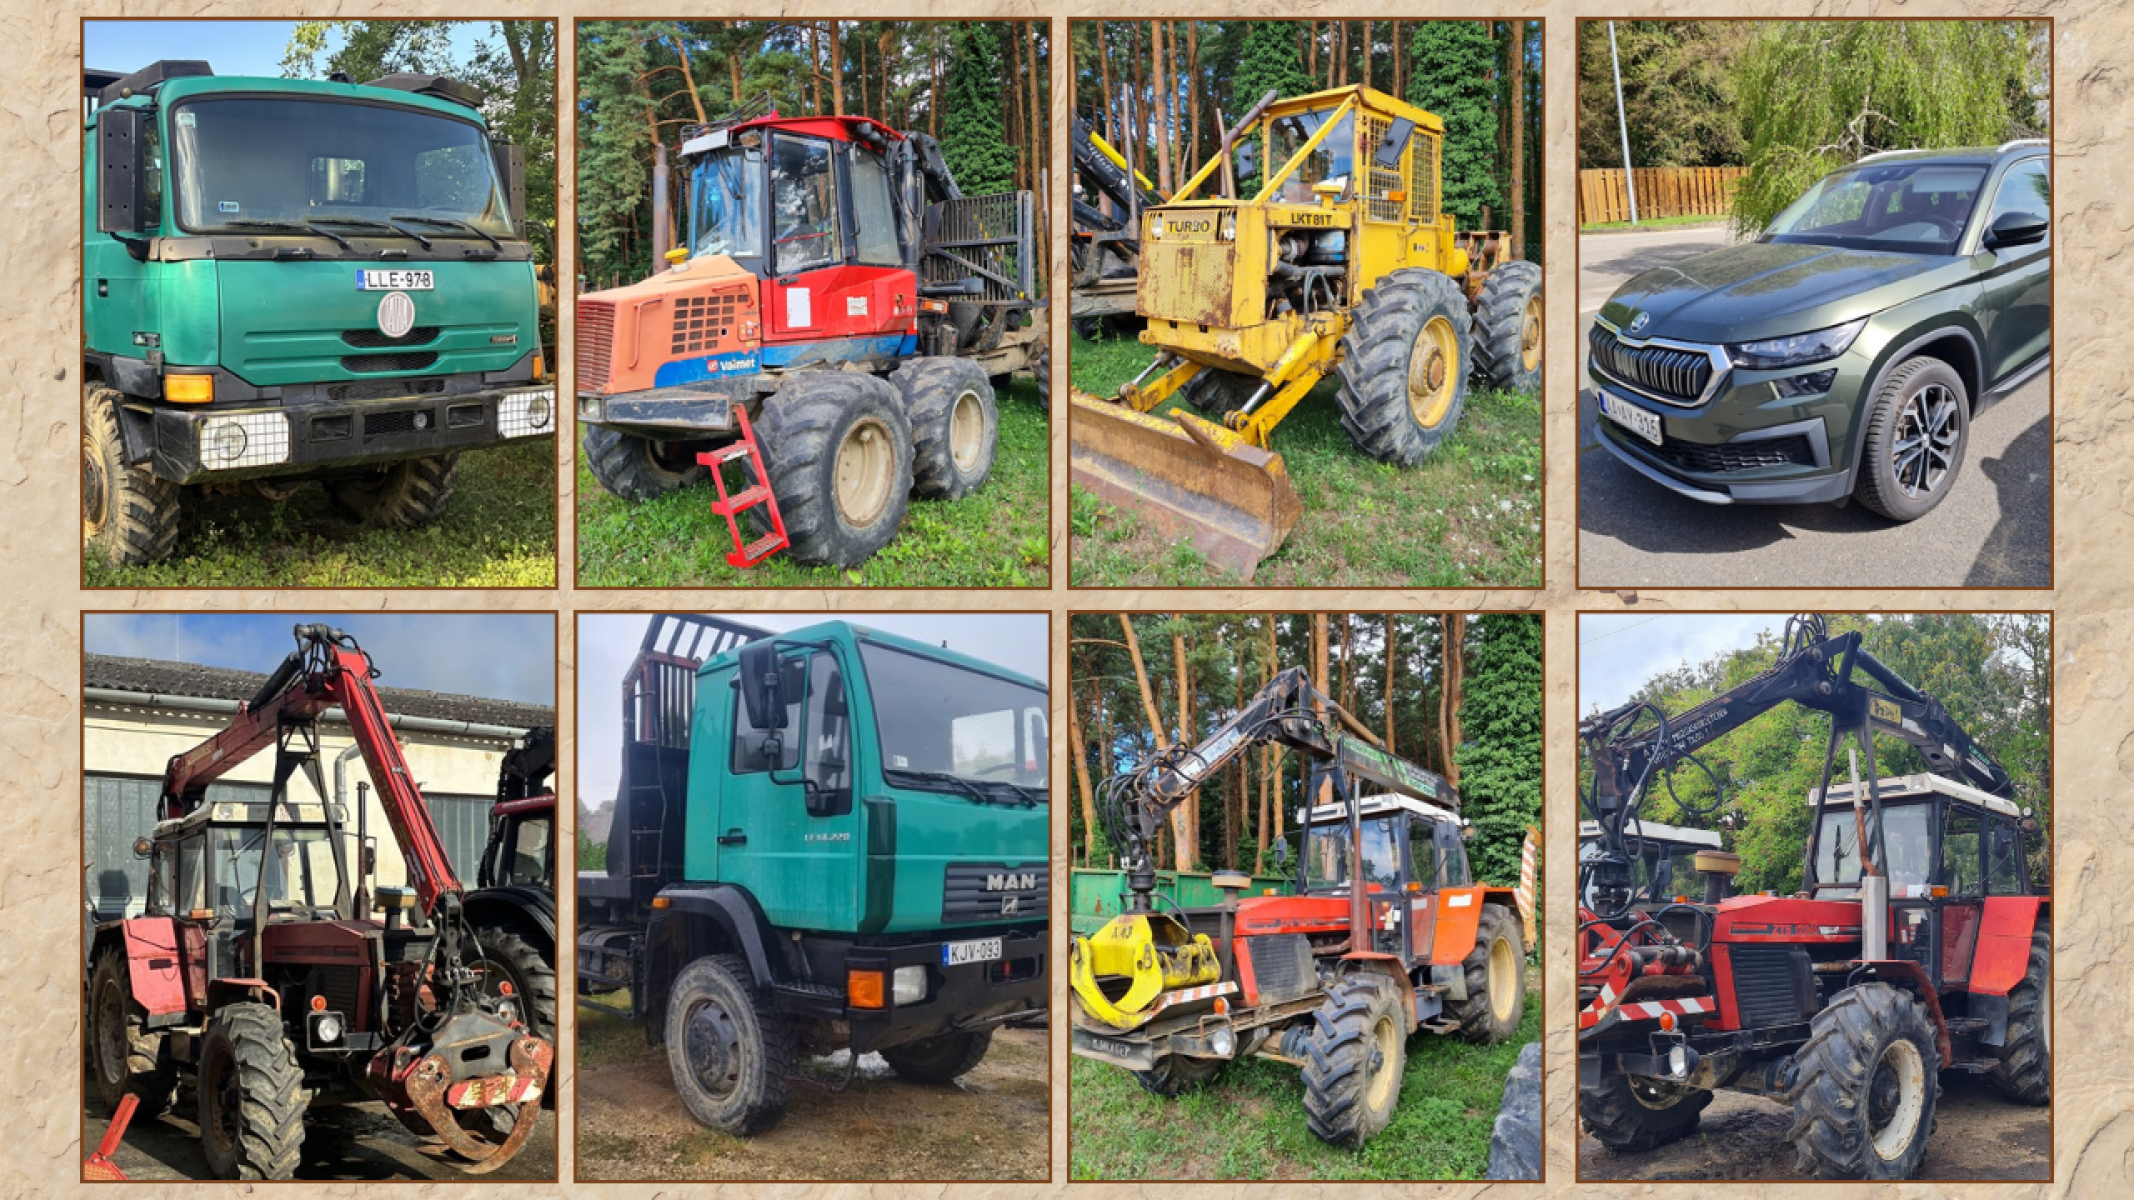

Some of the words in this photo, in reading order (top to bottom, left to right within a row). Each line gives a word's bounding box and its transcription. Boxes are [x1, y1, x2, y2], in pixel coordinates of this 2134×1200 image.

[368, 272, 432, 288] LLE-978
[720, 357, 756, 371] Valmet
[986, 873, 1037, 891] MAN
[951, 941, 1001, 962] KJV-093
